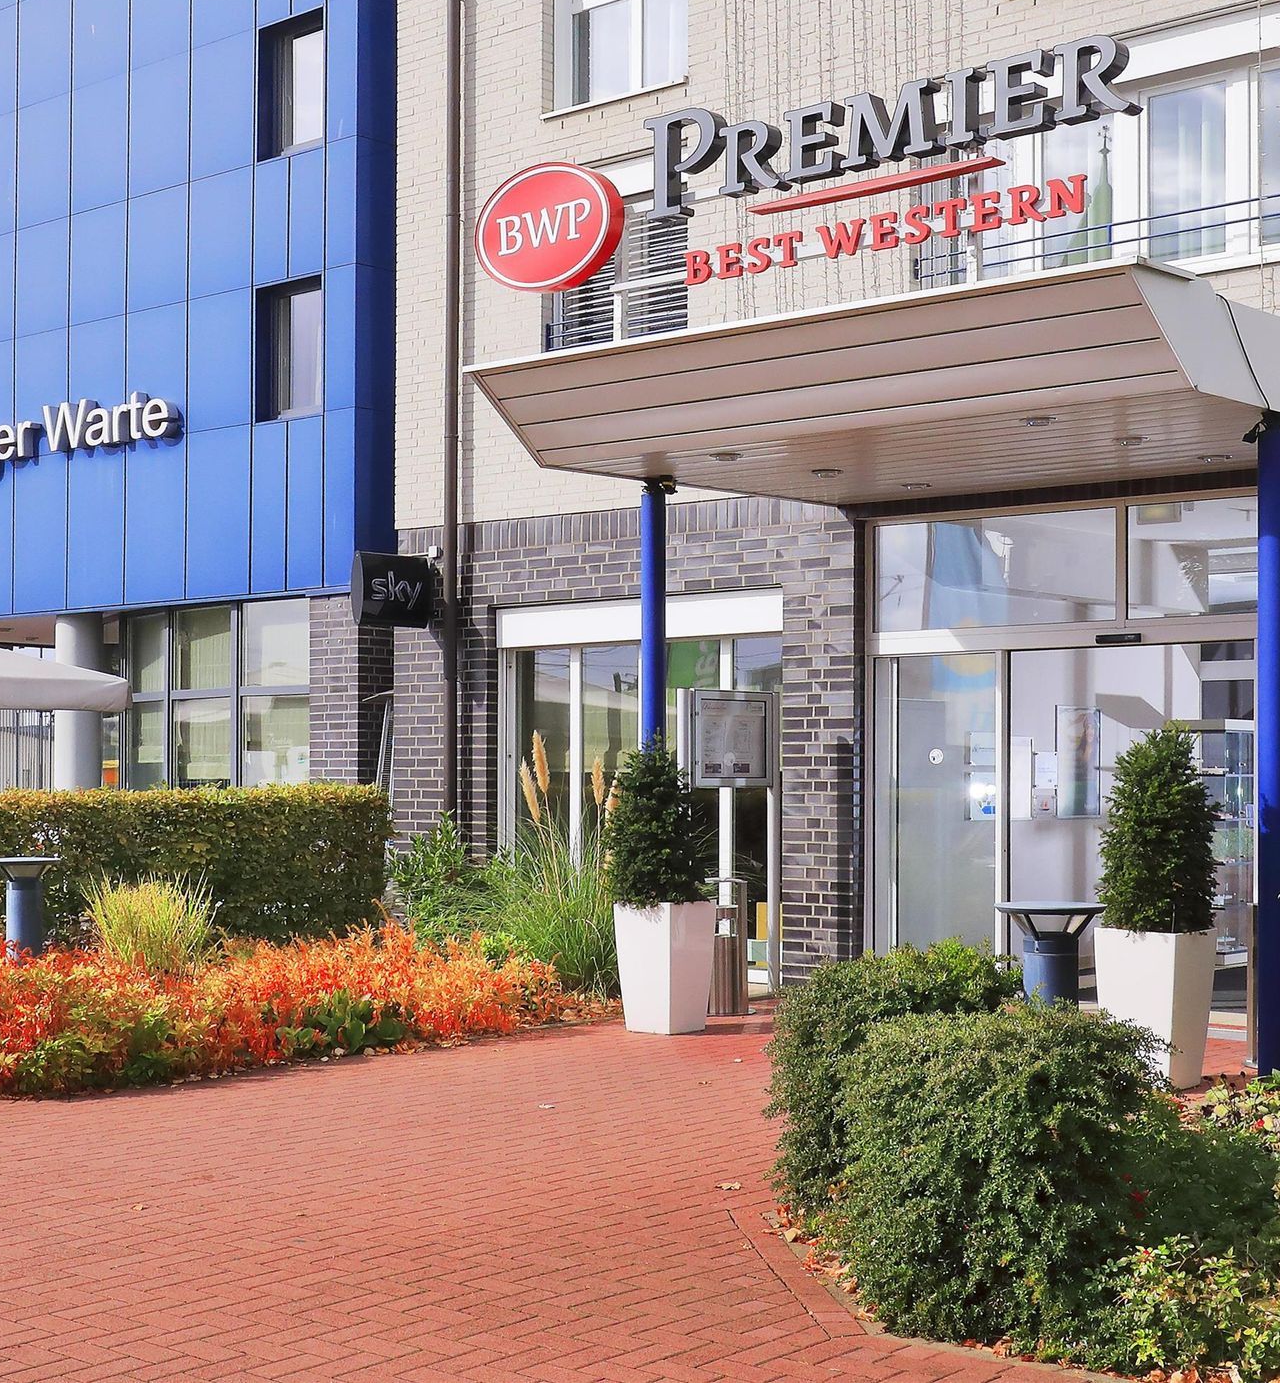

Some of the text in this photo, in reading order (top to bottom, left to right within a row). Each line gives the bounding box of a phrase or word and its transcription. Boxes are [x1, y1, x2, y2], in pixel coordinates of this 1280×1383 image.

[645, 34, 1136, 221] PREMIER
[495, 196, 592, 259] BWP
[684, 174, 1088, 286] BEST WESTERN
[42, 392, 170, 452] Warte
[371, 570, 423, 610] sky
